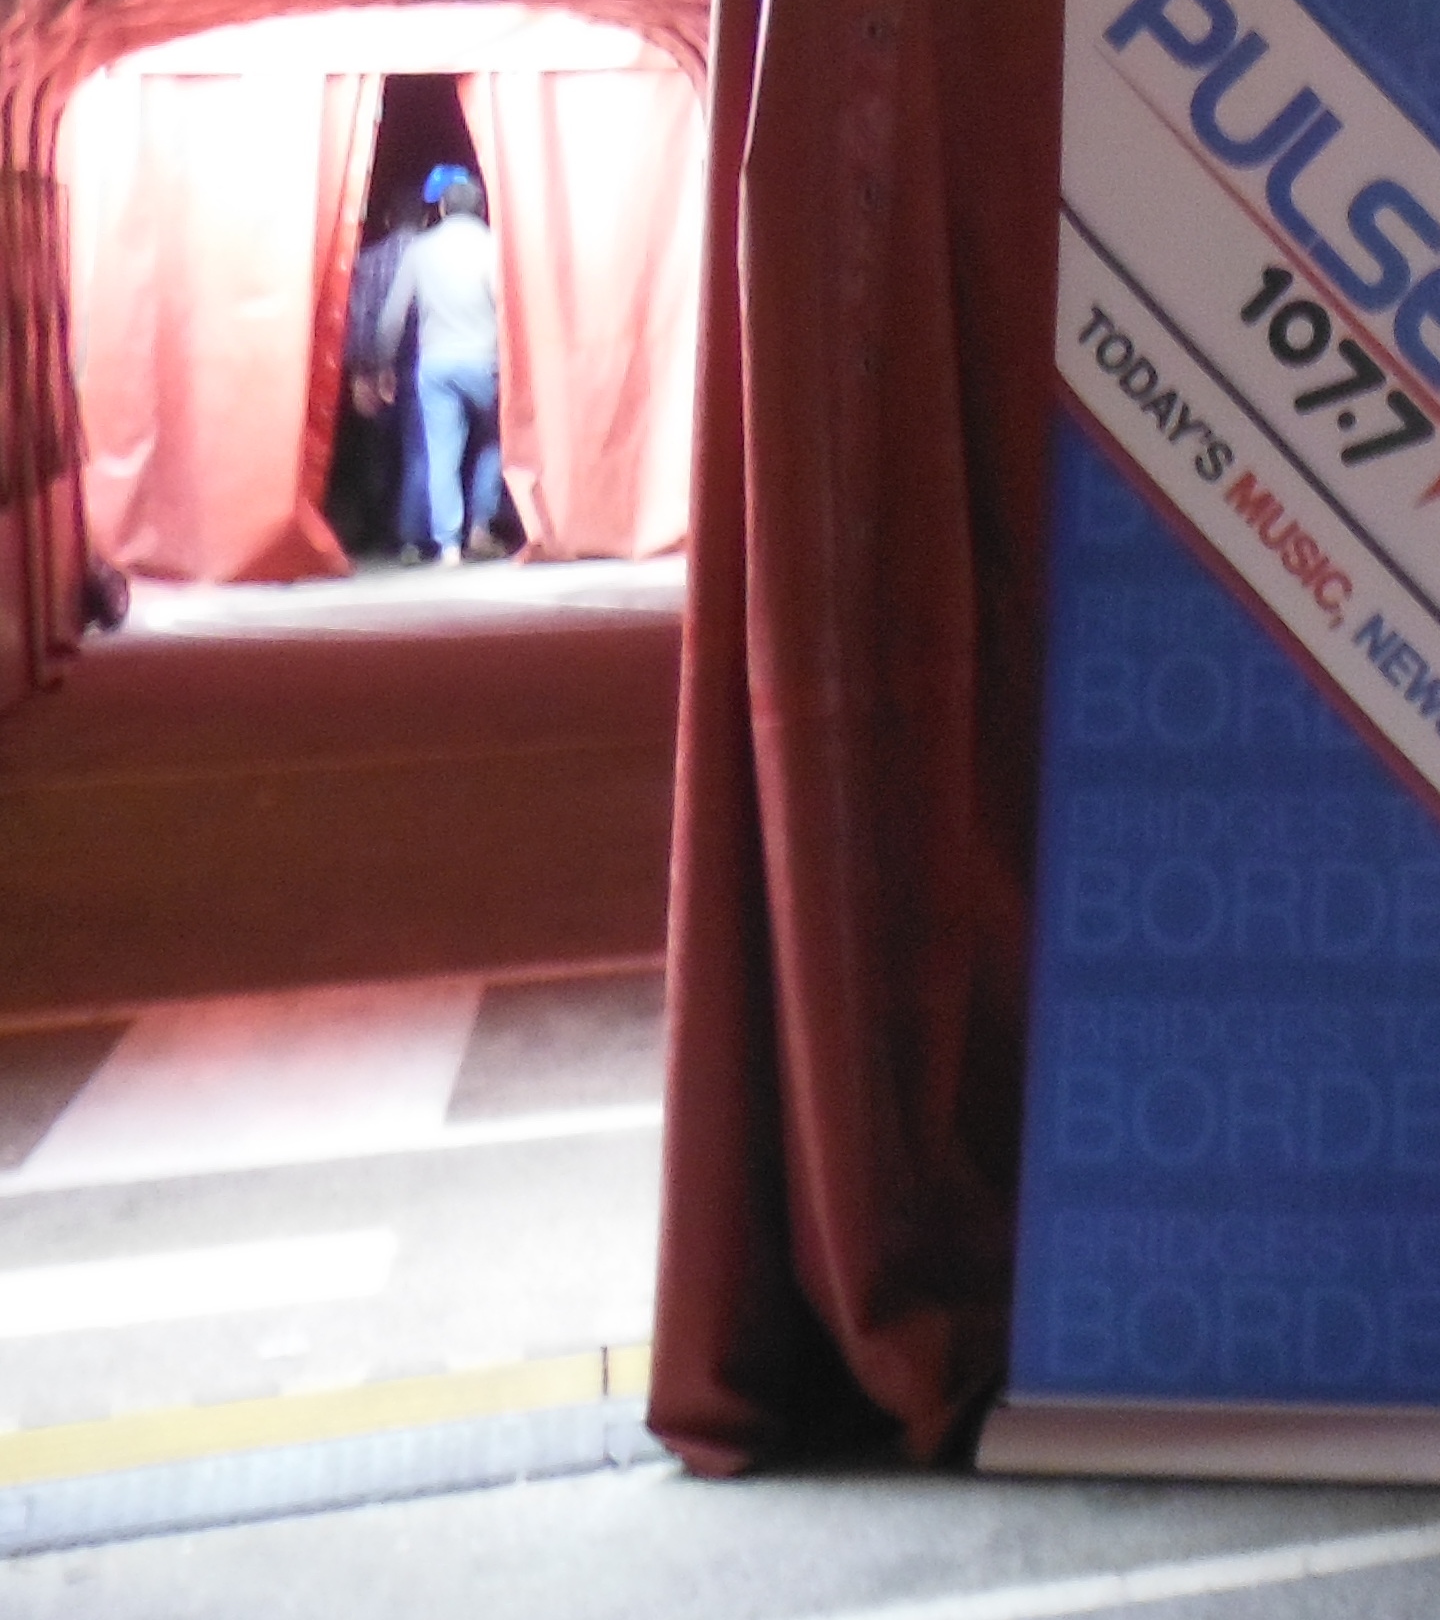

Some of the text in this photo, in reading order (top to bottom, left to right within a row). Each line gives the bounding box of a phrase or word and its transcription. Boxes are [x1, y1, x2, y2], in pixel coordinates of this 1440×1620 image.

[1076, 306, 1236, 482] TODAY'S
[1224, 471, 1354, 629] MUSIC,
[1240, 265, 1436, 468] 107.7
